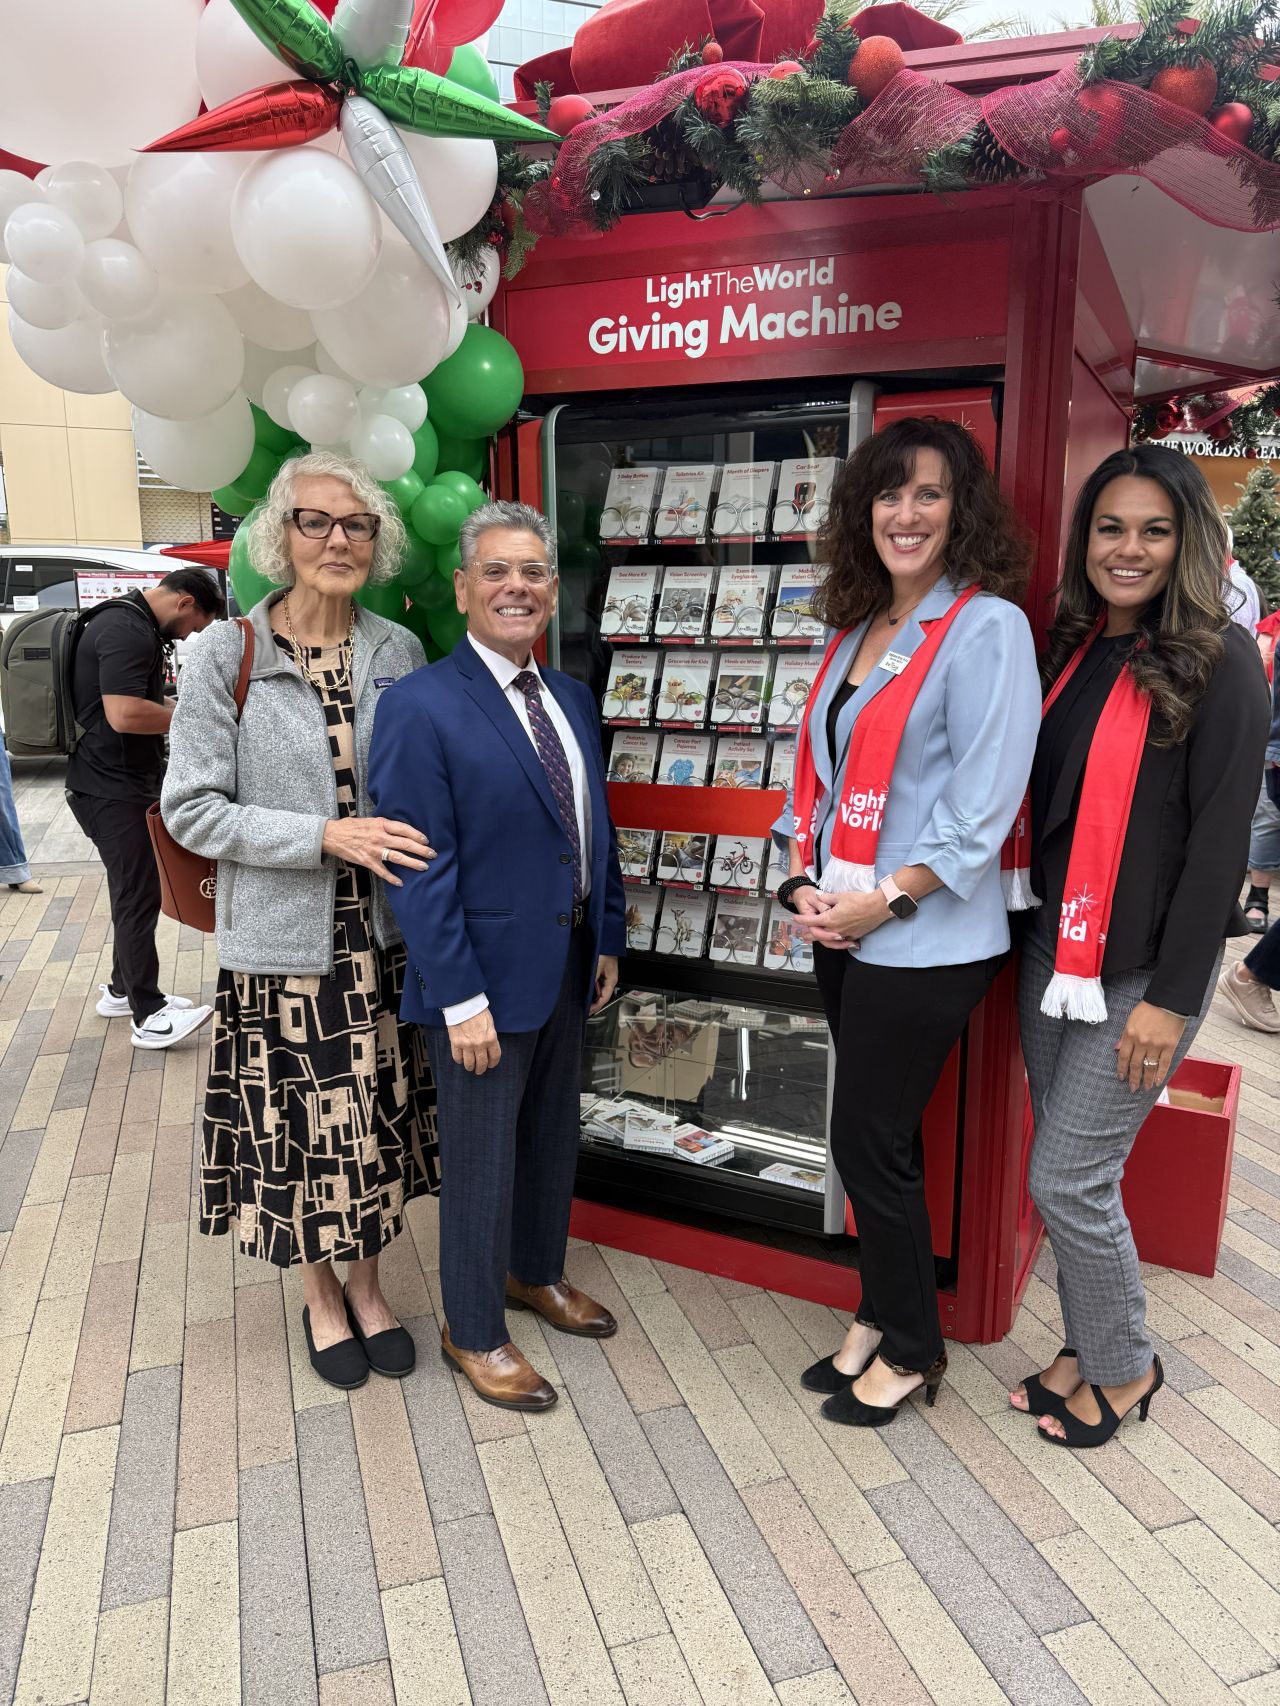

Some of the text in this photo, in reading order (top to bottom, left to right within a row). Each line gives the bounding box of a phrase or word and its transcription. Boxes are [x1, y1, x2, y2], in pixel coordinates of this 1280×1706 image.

[646, 256, 834, 309] LightTheWorld
[588, 292, 902, 359] Giving Machine
[841, 802, 882, 832] orl
[848, 786, 887, 812] ight
